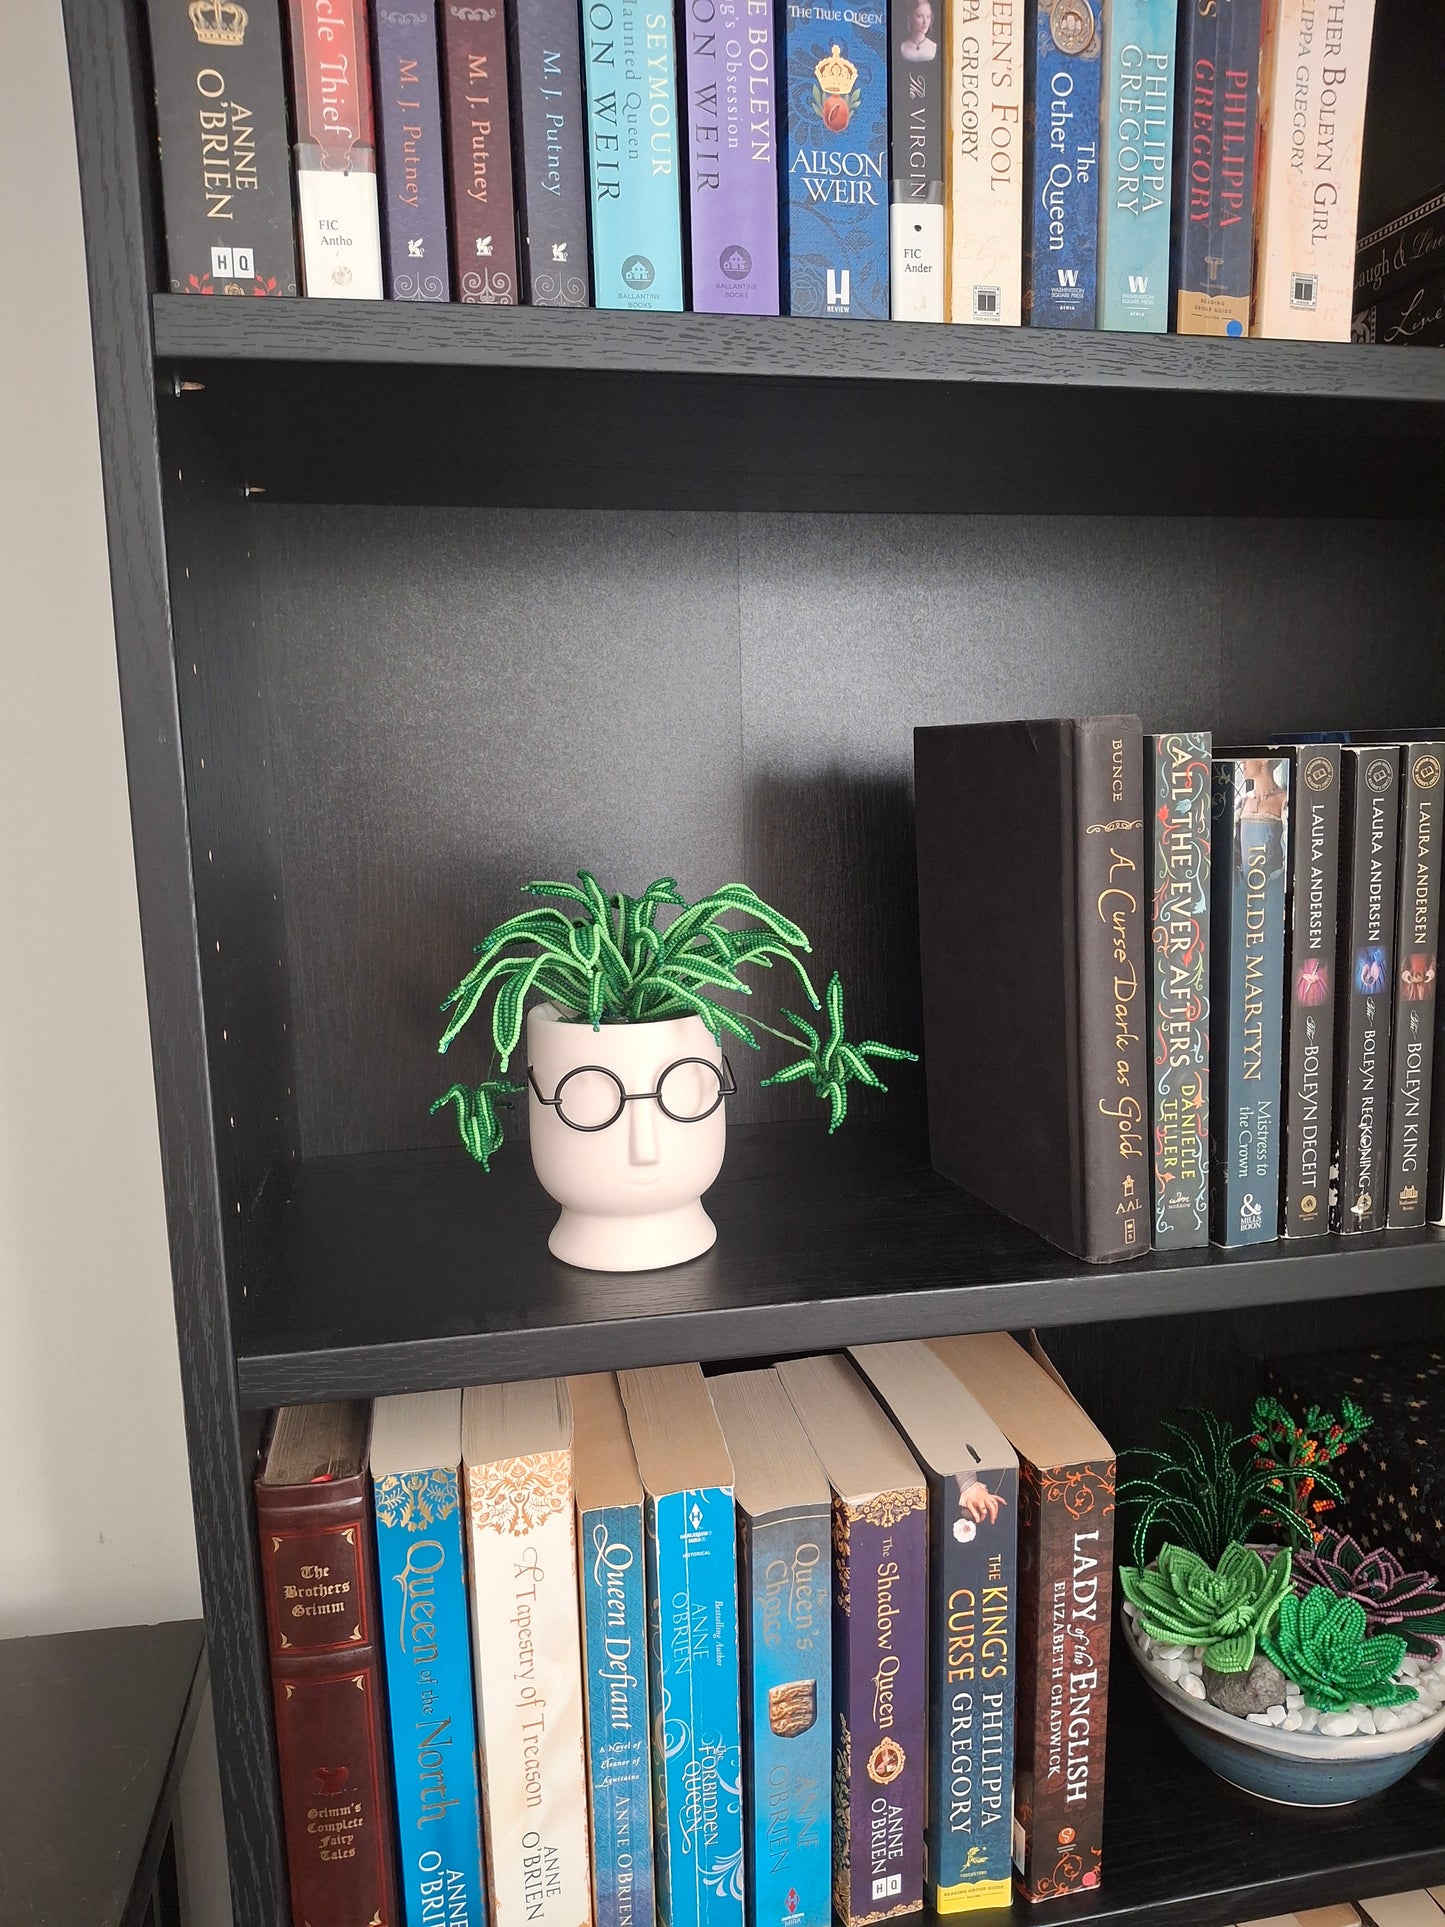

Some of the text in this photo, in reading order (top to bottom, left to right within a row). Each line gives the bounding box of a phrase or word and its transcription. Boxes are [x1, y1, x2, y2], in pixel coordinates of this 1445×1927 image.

[789, 5, 813, 19] THE
[813, 7, 843, 22] TRUE
[320, 53, 354, 140] Thief
[396, 58, 422, 209] M. J. Putney
[465, 53, 491, 203] M. J. Putney
[539, 49, 565, 197] M. J. Putney
[622, 91, 643, 161] Queen
[646, 14, 672, 177] SEYMOUR
[724, 39, 744, 149] Obsession
[747, 27, 770, 163] BOLEYN
[960, 36, 981, 162] GREGORY
[1116, 43, 1143, 217] GREGORY
[1141, 52, 1169, 213] PHILIPPA
[1290, 65, 1311, 175] GREGORY
[196, 68, 234, 221] O'BRIEN
[230, 100, 259, 192] ANNE
[591, 90, 621, 202] WEIR
[693, 81, 721, 193] WEIR
[788, 151, 886, 179] ALISON
[908, 72, 927, 199] The VIRGIN
[990, 103, 1020, 192] FOOL
[1041, 71, 1074, 251] Other Queen
[1076, 141, 1096, 184] The
[1189, 58, 1216, 230] GREGORY
[1218, 69, 1249, 228] PHILIPPA
[1310, 66, 1347, 247] BOLEYN GIRL
[319, 219, 340, 232] FIC
[800, 177, 880, 206] WEIR
[320, 235, 354, 247] Antho
[903, 247, 922, 260] FIC
[904, 261, 934, 274] Ander
[1057, 269, 1080, 288] W
[617, 292, 661, 301] BALLANTINE
[627, 301, 653, 309] BOOKS
[715, 283, 758, 291] BALLANTINE
[724, 291, 749, 299] BOOKS
[826, 304, 851, 314] REVIEW
[1127, 275, 1151, 294] W
[1112, 739, 1124, 802] BUNCE
[1310, 804, 1325, 861] LAURA
[1371, 797, 1385, 854] LAURA
[1418, 801, 1432, 858] LAURA
[1168, 744, 1194, 1068] ALL THE EVER AFTERS
[1308, 866, 1324, 949] ANDERSEN
[1367, 859, 1382, 942] ANDERSEN
[1413, 863, 1429, 945] ANDERSEN
[1243, 843, 1267, 1081] ISOLDE MARTYN
[1097, 847, 1143, 1160] A Curse Dark as Gold
[1297, 1044, 1320, 1122] BOLEYN
[1358, 1029, 1376, 1091] BOLEYN
[1162, 1099, 1179, 1169] TELLER
[1181, 1084, 1197, 1180] DANIELLE
[1238, 1106, 1255, 1178] the Crown
[1256, 1099, 1273, 1176] Mistress to
[1400, 1041, 1422, 1173] BOLEYN KING
[1300, 1124, 1319, 1188] DECEIT
[1240, 1192, 1263, 1219] &
[283, 1580, 351, 1600] Brothers
[291, 1600, 345, 1618] Grimm
[299, 1564, 331, 1580] The
[790, 1542, 821, 1651] Queen's
[509, 1583, 538, 1681] Tapestry
[592, 1523, 638, 1731] Queen Defiant
[691, 1602, 710, 1660] ANNE
[871, 1535, 901, 1730] The Shadow Queen
[947, 1588, 975, 1683] CURSE
[980, 1553, 1009, 1679] THE KING'S
[392, 1539, 461, 1831] Queen of the North
[515, 1685, 547, 1708] of
[1047, 1580, 1067, 1779] ELIZABETH CHADWICK
[1067, 1529, 1100, 1803] LADY of the ENGLISH
[521, 1712, 546, 1809] Treason
[594, 1774, 640, 1789] Aquitaine
[599, 1740, 643, 1754] A Novel of
[600, 1756, 642, 1769] Eleanor of
[949, 1691, 974, 1835] GREGORY
[980, 1690, 1004, 1828] PHILIPPA
[307, 1801, 362, 1820] Grimm's
[307, 1817, 364, 1834] Complete
[318, 1832, 355, 1850] Fairy
[795, 1774, 819, 1852] ANNE
[871, 1797, 888, 1876] O'BRIEN
[887, 1804, 904, 1861] ANNE
[319, 1847, 357, 1862] Tales
[418, 1849, 446, 1927] O'BRI
[521, 1830, 545, 1922] O'BRIEN
[543, 1845, 562, 1898] ANNE
[615, 1794, 634, 1927] ANNE O'BRIEN
